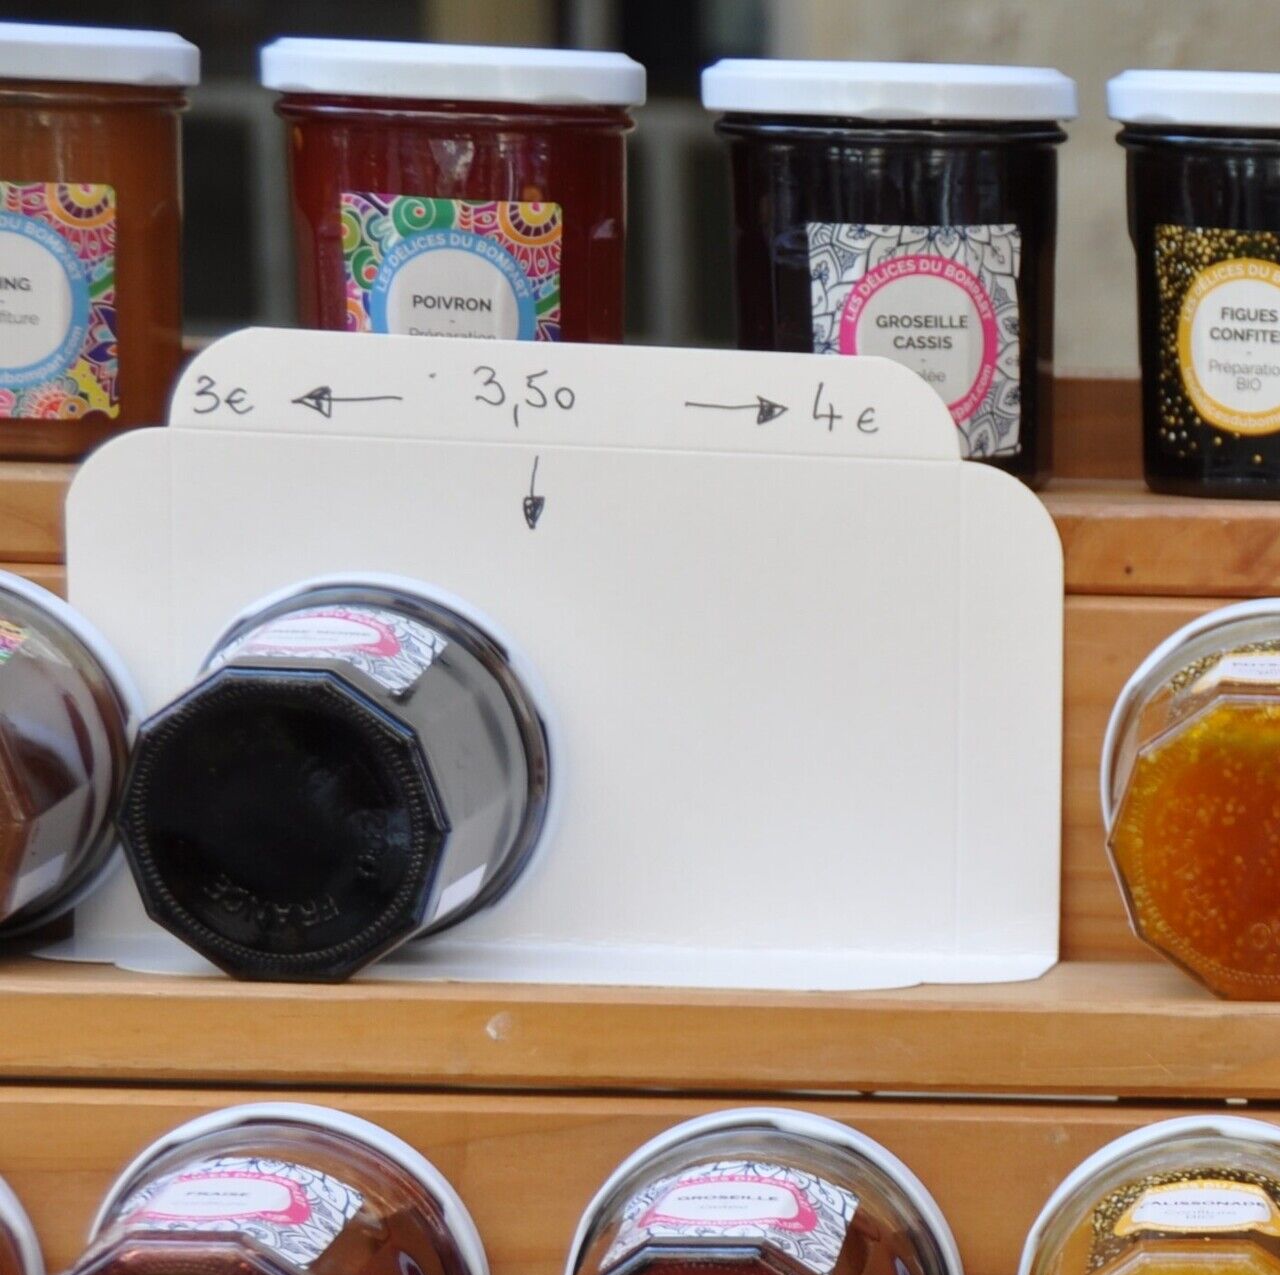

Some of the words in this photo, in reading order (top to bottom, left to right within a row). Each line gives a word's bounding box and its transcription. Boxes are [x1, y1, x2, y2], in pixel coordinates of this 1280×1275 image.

[450, 233, 474, 248] DU
[1248, 263, 1270, 277] DU
[919, 258, 942, 272] DU
[944, 265, 994, 320] BOMPART
[412, 294, 493, 313] POIVRON
[1220, 306, 1279, 323] FIGUES
[875, 315, 969, 330] GROSEILLE
[893, 335, 954, 350] CASSIS
[1235, 377, 1262, 392] BIO
[193, 374, 255, 414] 3€
[473, 365, 577, 428] 3,50
[677, 1194, 778, 1202] GROSEILLE
